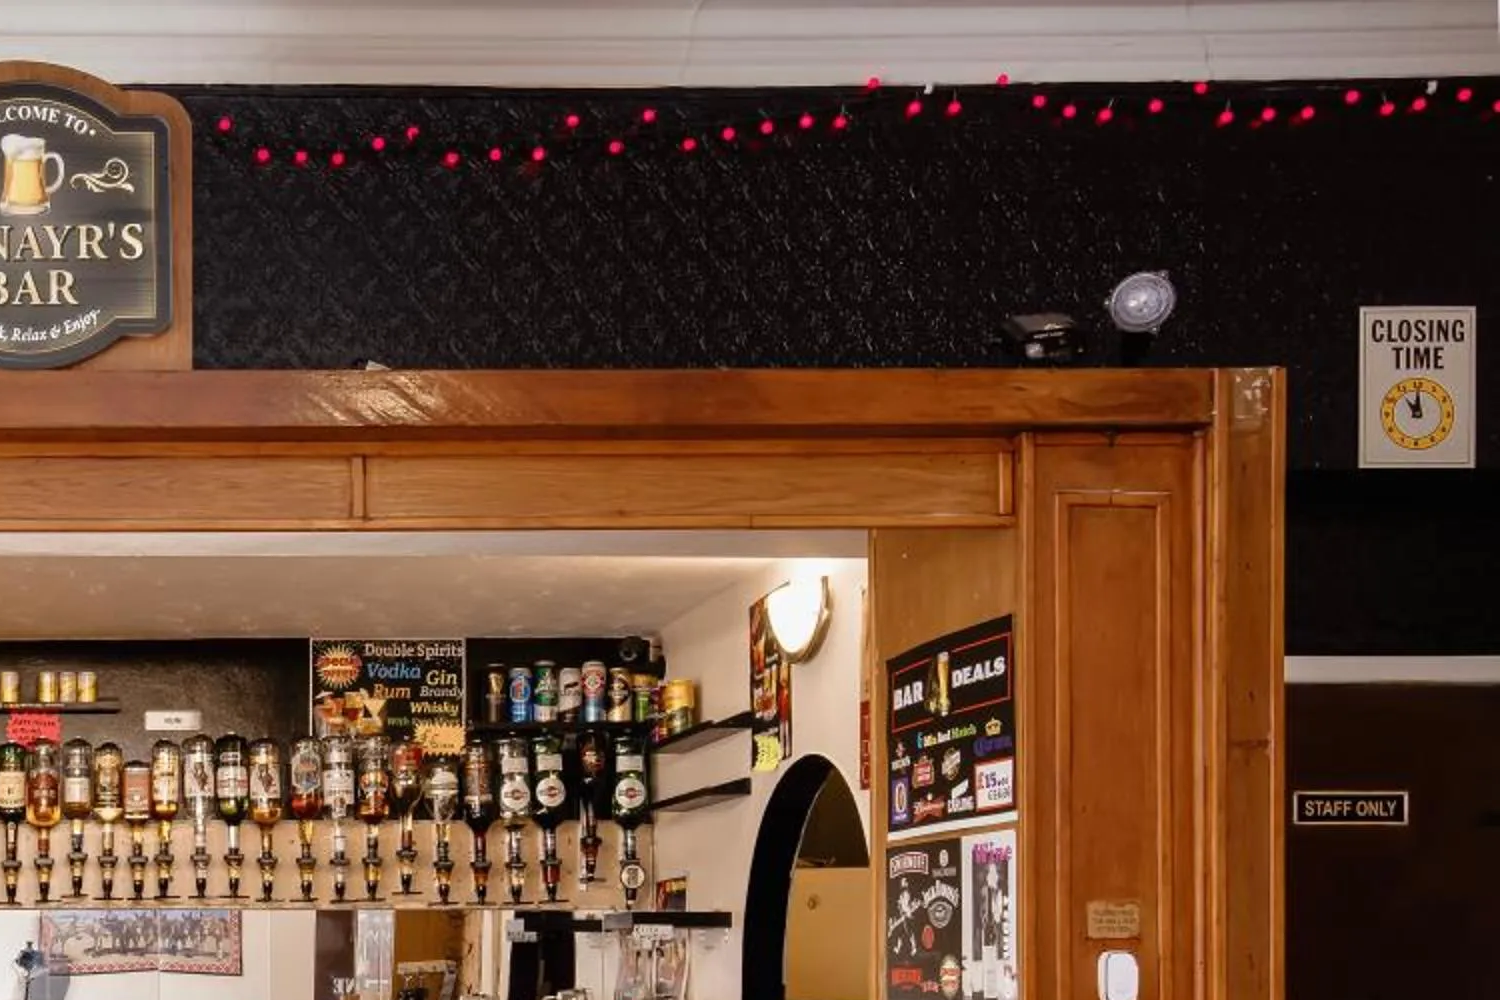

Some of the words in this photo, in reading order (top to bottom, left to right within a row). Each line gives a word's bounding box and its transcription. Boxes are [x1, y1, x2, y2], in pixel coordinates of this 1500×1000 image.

[65, 112, 88, 134] TO
[11, 327, 47, 342] Relax
[1371, 319, 1465, 343] CLOSING
[1391, 347, 1444, 370] TIME
[365, 643, 415, 657] Double
[418, 643, 464, 660] Spirits
[367, 662, 421, 679] Vodka
[426, 669, 457, 686] Gin
[373, 683, 411, 699] Rum
[893, 681, 924, 711] BAR
[952, 656, 1006, 689] DEALS
[420, 686, 464, 700] Brandy
[410, 701, 459, 717] Whisky
[1304, 800, 1352, 817] STAFF
[1355, 800, 1397, 817] ONLY
